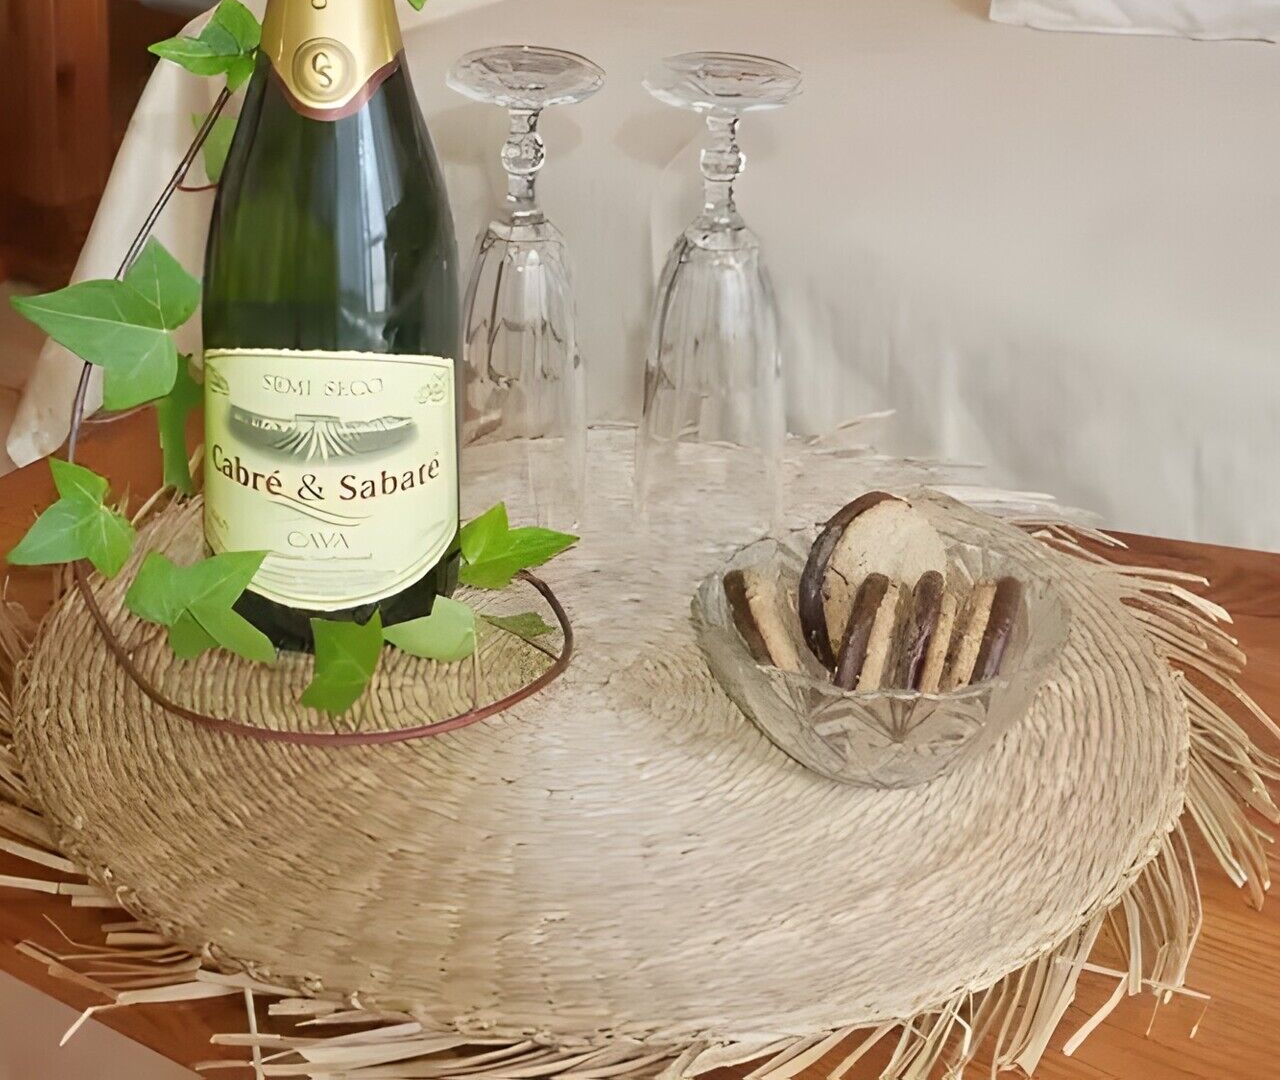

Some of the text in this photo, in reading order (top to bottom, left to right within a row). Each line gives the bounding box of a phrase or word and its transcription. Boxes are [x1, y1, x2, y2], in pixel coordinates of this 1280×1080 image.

[211, 444, 441, 502] Cabré & Sabaté
[287, 531, 350, 549] CAVA
